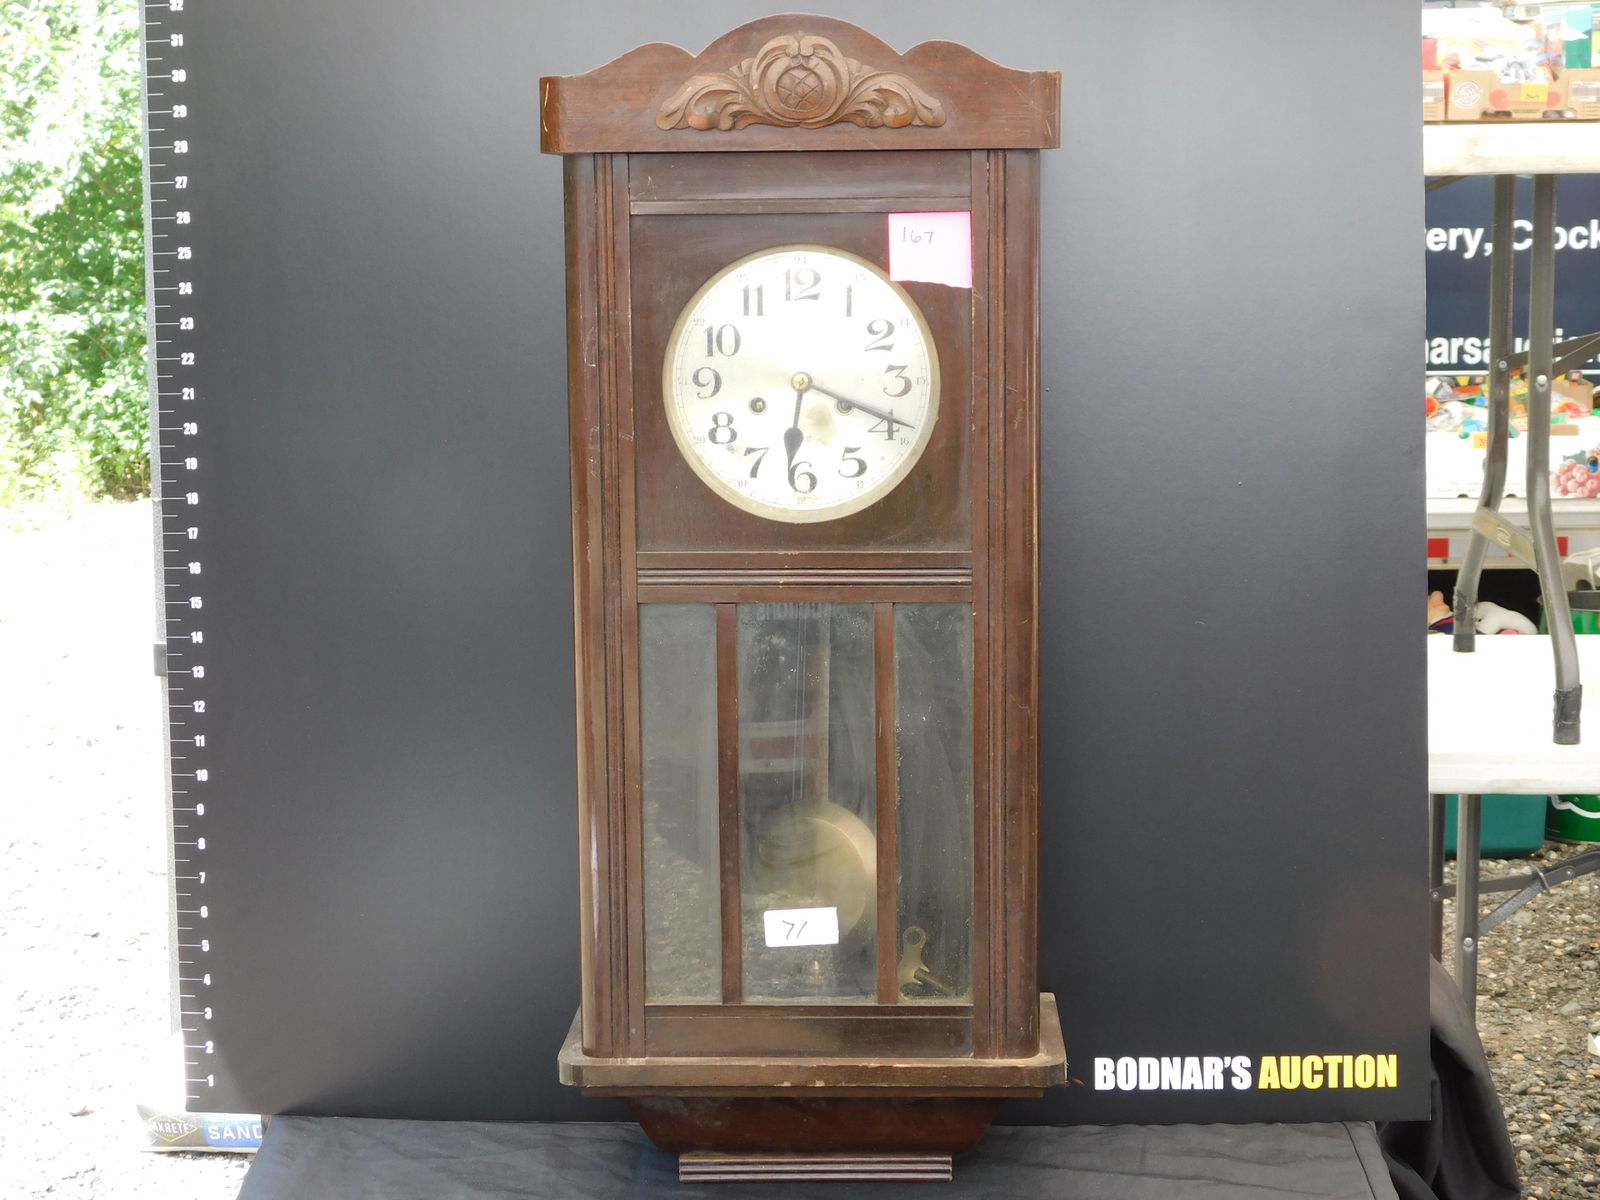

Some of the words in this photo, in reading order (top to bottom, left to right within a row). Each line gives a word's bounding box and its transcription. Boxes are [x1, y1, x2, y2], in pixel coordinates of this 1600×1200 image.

[170, 0, 184, 11] 32
[171, 34, 183, 47] 31
[172, 69, 186, 82] 30
[173, 105, 187, 118] 29
[174, 140, 188, 153] 28
[175, 176, 188, 189] 27
[177, 211, 190, 224] 26
[902, 226, 934, 244] 167
[178, 247, 191, 260] 25
[179, 282, 192, 295] 24
[782, 268, 821, 301] 12
[742, 284, 764, 317] 11
[845, 284, 853, 317] 1
[181, 317, 194, 330] 23
[704, 324, 741, 357] 10
[865, 319, 895, 352] 2
[182, 352, 194, 365] 22
[692, 366, 722, 400] 9
[883, 365, 912, 398] 3
[183, 388, 194, 400] 21
[185, 422, 197, 435] 20
[708, 412, 737, 445] 8
[867, 409, 900, 441] 4
[186, 457, 197, 470] 19
[744, 447, 769, 479] 7
[838, 447, 867, 478] 5
[788, 461, 817, 494] 6
[187, 492, 198, 505] 18
[188, 527, 198, 540] 17
[190, 562, 201, 575] 16
[191, 597, 202, 610] 15
[192, 631, 203, 644] 14
[193, 666, 204, 679] 13
[194, 700, 206, 713] 12
[195, 735, 205, 747] 11
[196, 769, 208, 782] 10
[196, 803, 205, 816] 9
[197, 837, 206, 850] 8
[199, 872, 206, 884] 7
[200, 906, 208, 918] 6
[201, 940, 210, 952] 5
[203, 974, 211, 986] 4
[204, 1007, 212, 1020] 3
[205, 1041, 214, 1054] 2
[1094, 1056, 1252, 1091] BODNAR'S
[1258, 1054, 1397, 1090] AUCTION
[207, 1074, 214, 1087] 1
